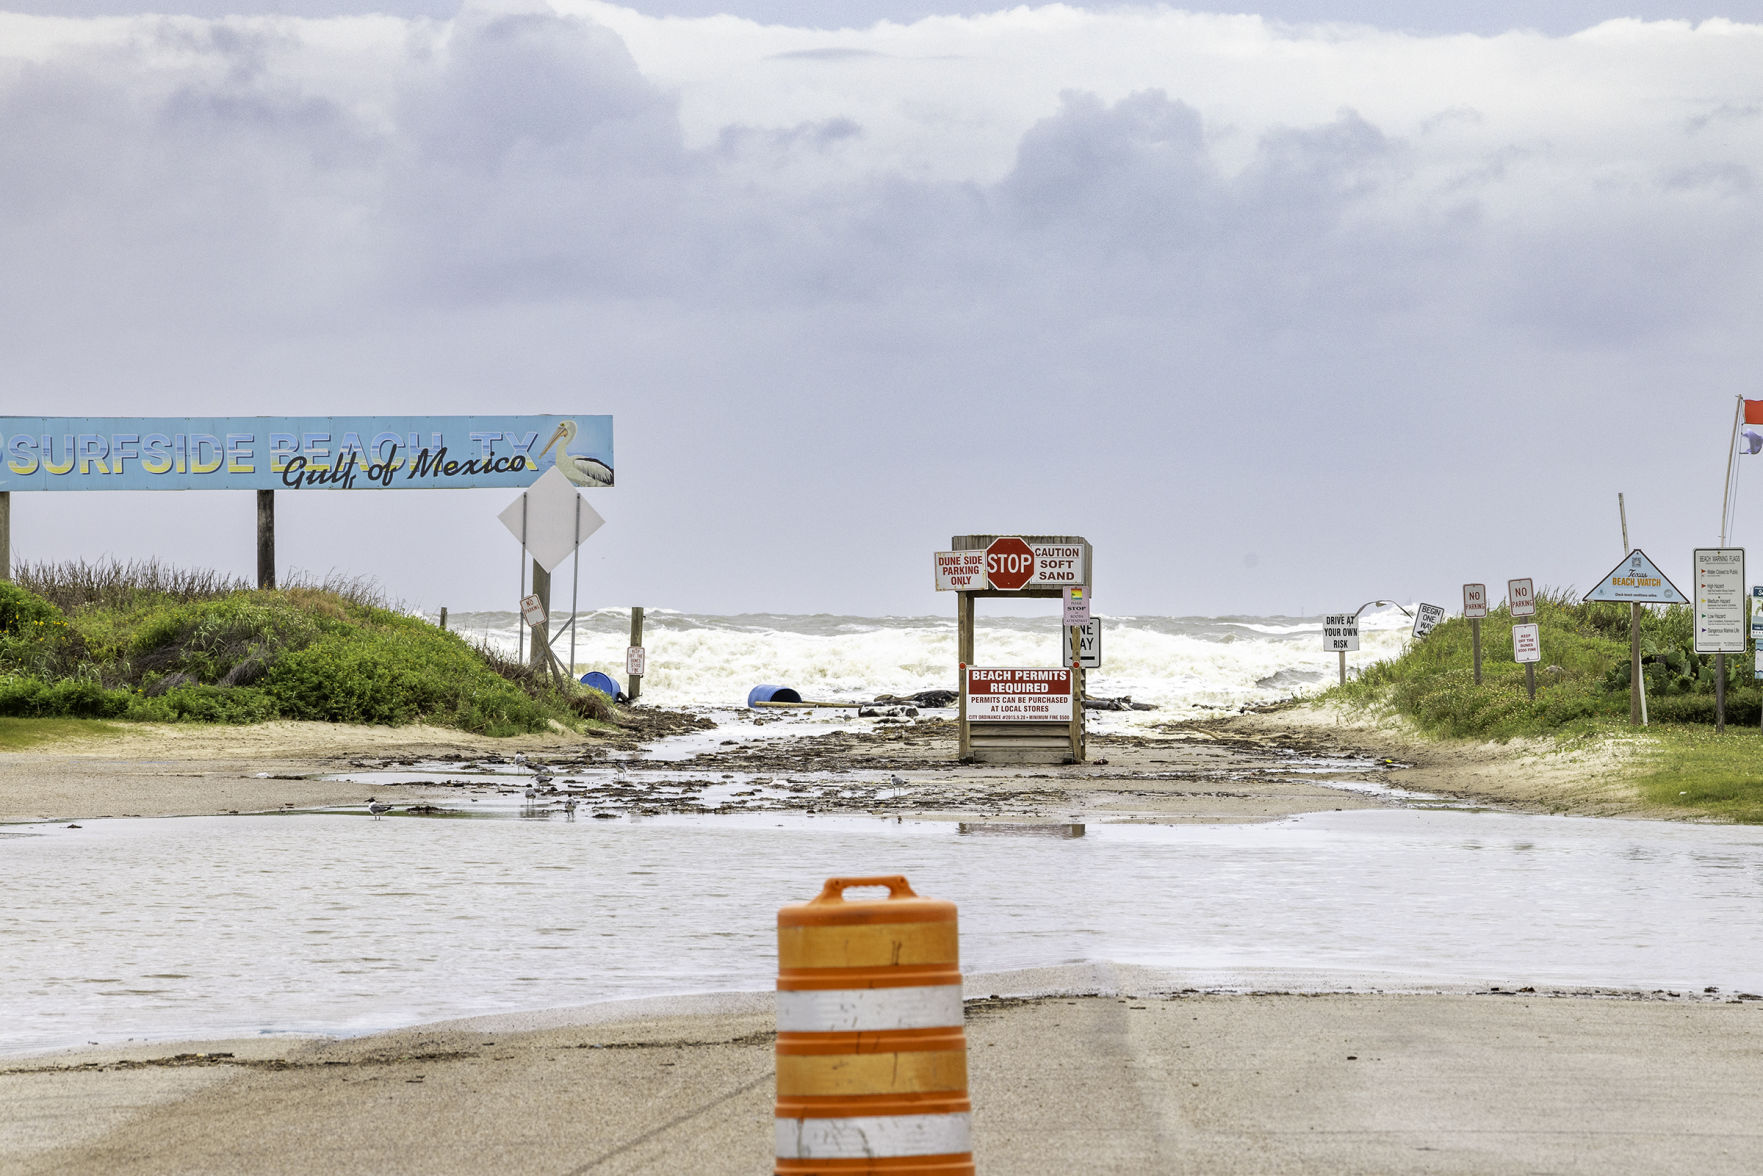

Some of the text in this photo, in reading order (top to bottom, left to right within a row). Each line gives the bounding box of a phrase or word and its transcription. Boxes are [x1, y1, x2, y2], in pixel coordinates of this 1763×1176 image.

[8, 432, 539, 475] SURFSIDE BEACH TX
[282, 443, 526, 489] Gulf of Mexico
[1035, 547, 1080, 558] CAUTION
[938, 555, 983, 566] DUNE SIDE
[987, 553, 1032, 573] STOP
[1040, 560, 1074, 569] SOFT
[942, 565, 980, 575] PARKING
[1628, 568, 1648, 577] Texas
[950, 576, 972, 586] ONLY
[1039, 572, 1075, 581] SAND
[1612, 577, 1661, 587] BEACH WATCH
[1469, 591, 1481, 600] NO
[1515, 587, 1528, 597] NO
[1512, 599, 1533, 608] PARKING
[1421, 605, 1441, 616] BEGIN
[1326, 616, 1355, 625] DRIVE AT
[1423, 614, 1436, 623] ONE
[1420, 621, 1434, 630] WAY
[1324, 627, 1358, 637] YOUR OWN
[1333, 639, 1348, 648] RISK
[972, 670, 1067, 681] BEACH PERMITS
[990, 683, 1049, 693] REQUIRED
[971, 696, 1068, 704] PERMITS CAN BE PURCHASED
